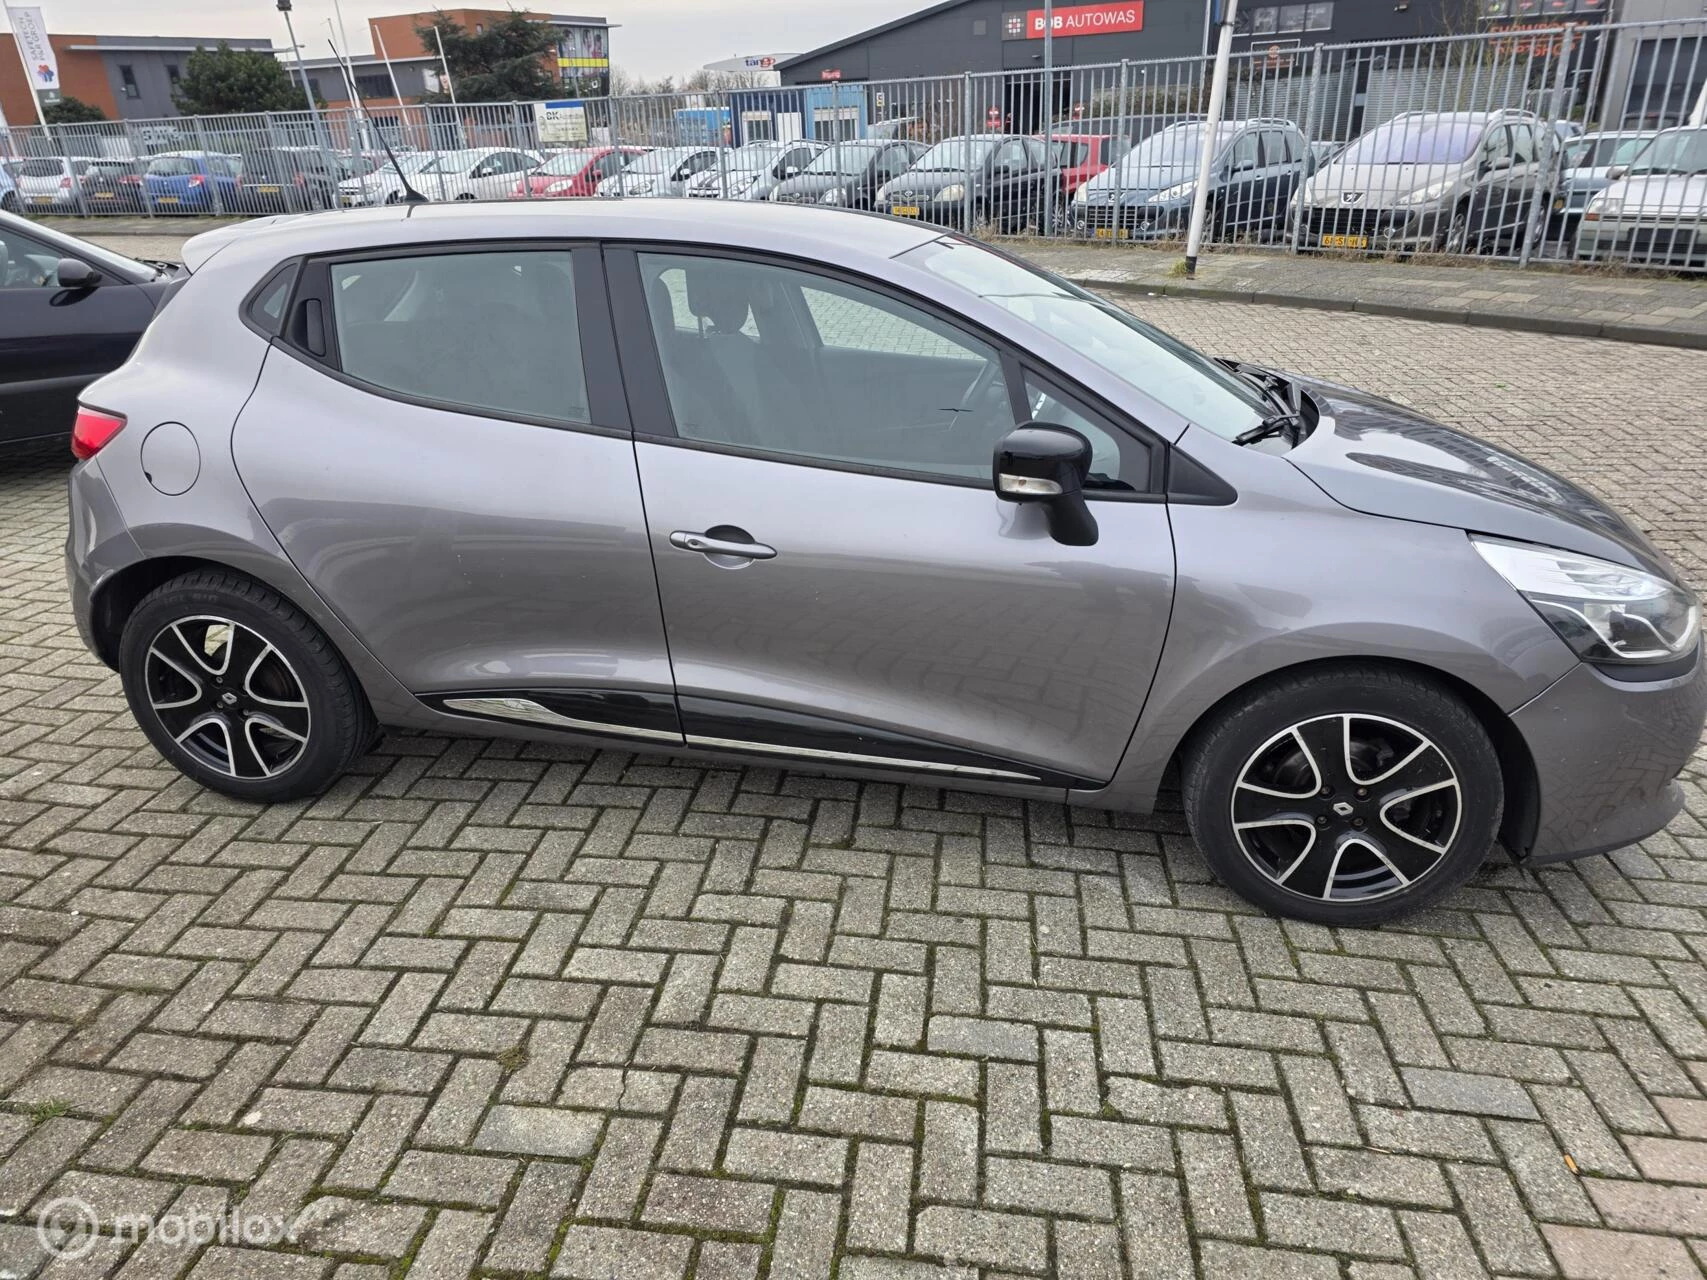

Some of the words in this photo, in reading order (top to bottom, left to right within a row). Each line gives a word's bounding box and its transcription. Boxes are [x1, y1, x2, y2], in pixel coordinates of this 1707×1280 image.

[23, 11, 41, 42] GROEP
[1034, 16, 1063, 31] BB
[1065, 10, 1136, 28] AUTOWAS
[1489, 21, 1588, 37] SHOWROM
[18, 16, 40, 61] SAFETECH
